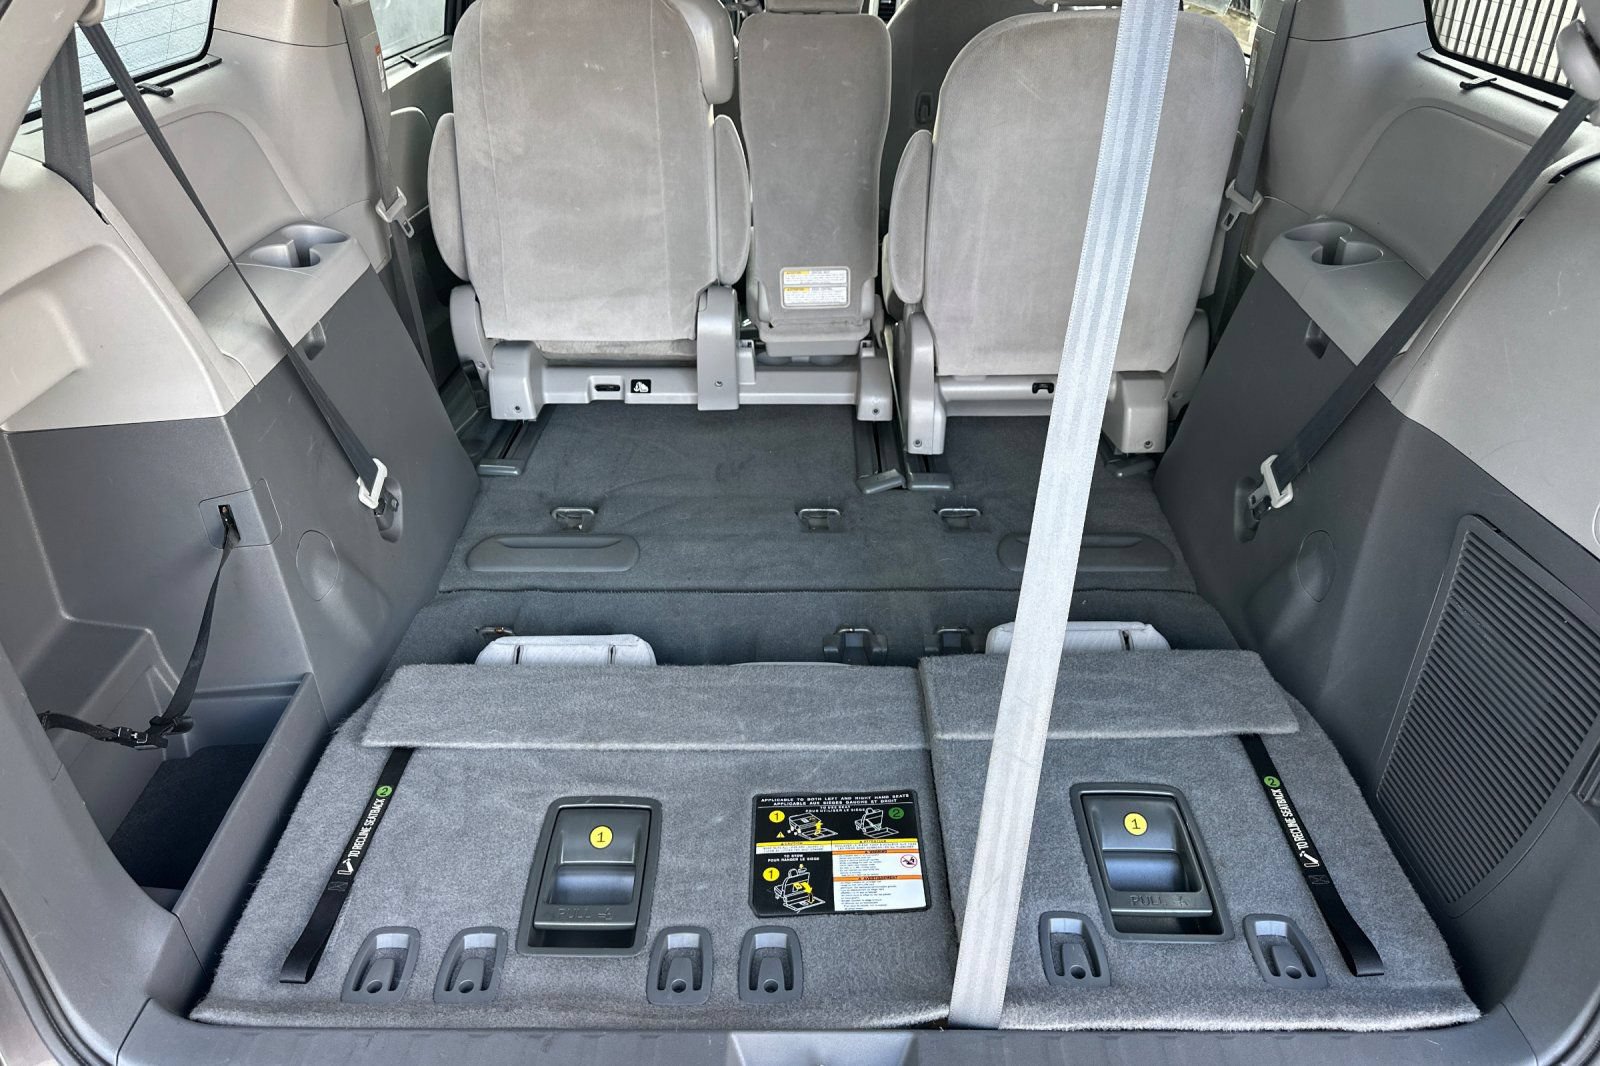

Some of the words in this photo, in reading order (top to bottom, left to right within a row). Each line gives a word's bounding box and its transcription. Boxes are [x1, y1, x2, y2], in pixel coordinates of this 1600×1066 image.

[380, 787, 388, 796] 2
[1270, 788, 1294, 817] SEATBACK
[364, 798, 386, 826] SEATBACK
[892, 808, 901, 817] 2
[1131, 818, 1141, 830] 1
[1284, 817, 1306, 842] RECLINE
[352, 826, 372, 850] RECLINE
[596, 831, 606, 843] 1
[1295, 841, 1309, 850] TO
[348, 850, 361, 858] TO
